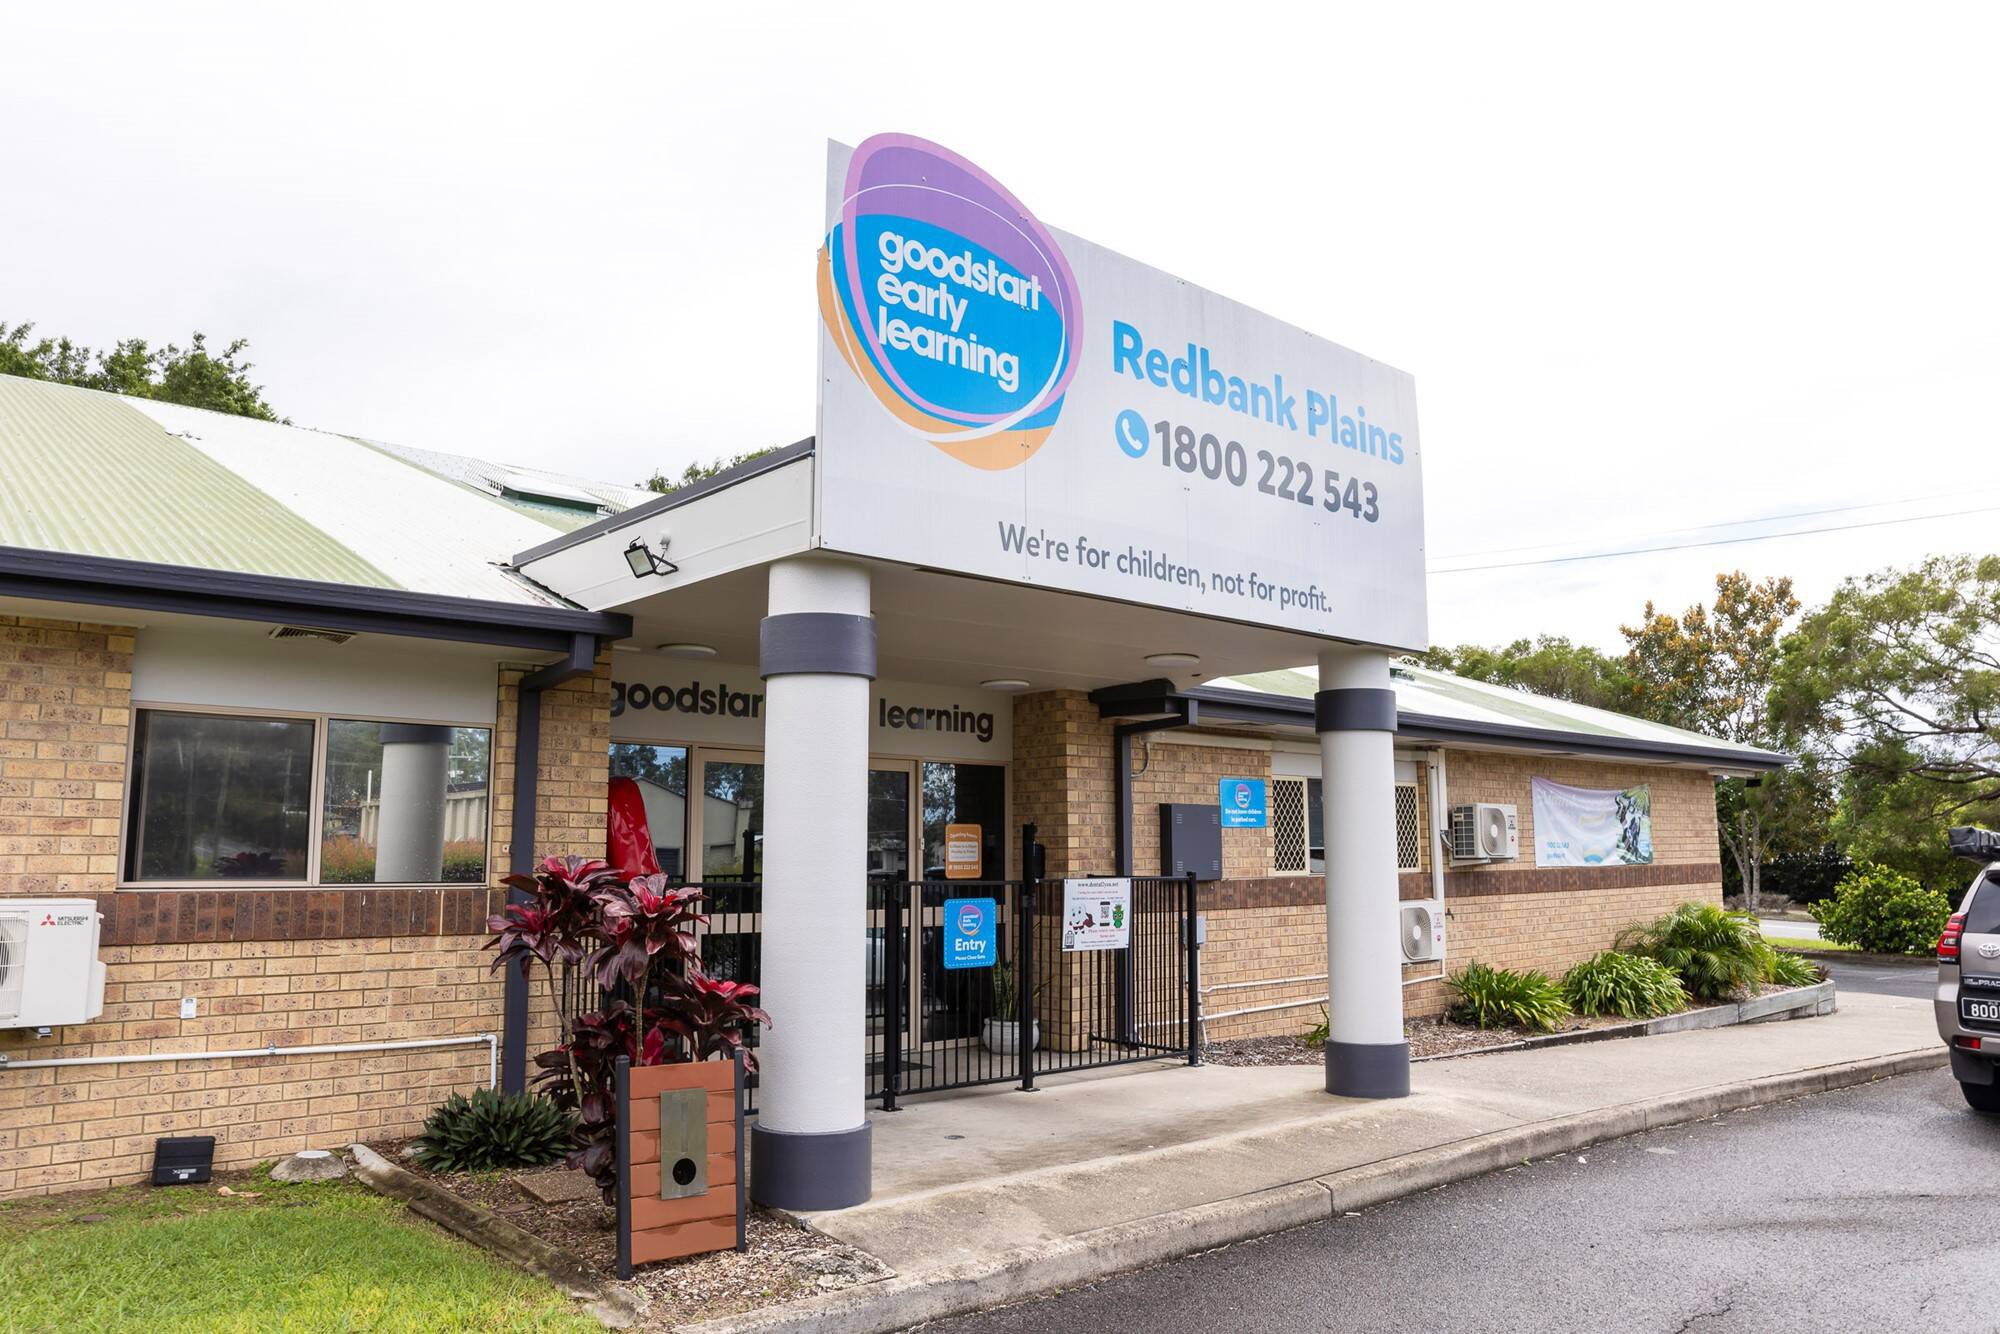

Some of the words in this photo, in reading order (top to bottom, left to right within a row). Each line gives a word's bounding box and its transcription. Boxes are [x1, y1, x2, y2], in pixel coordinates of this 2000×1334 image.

[878, 231, 1041, 311] goodstart
[878, 273, 968, 333] early
[878, 305, 1019, 393] learning
[1112, 319, 1297, 432] Redbank
[1306, 388, 1404, 465] Plains
[1155, 421, 1247, 487] 1800
[1258, 451, 1314, 506] 222
[1324, 471, 1379, 523] 543
[999, 522, 1069, 562] We're
[1076, 536, 1111, 570] for
[1117, 546, 1206, 595] children,
[1212, 573, 1245, 597] not
[1249, 572, 1276, 602] for
[1280, 585, 1332, 613] profit.
[610, 681, 764, 718] goodstar
[879, 697, 994, 743] learning
[955, 938, 986, 954] Entry
[1971, 1003, 2000, 1018] 800
